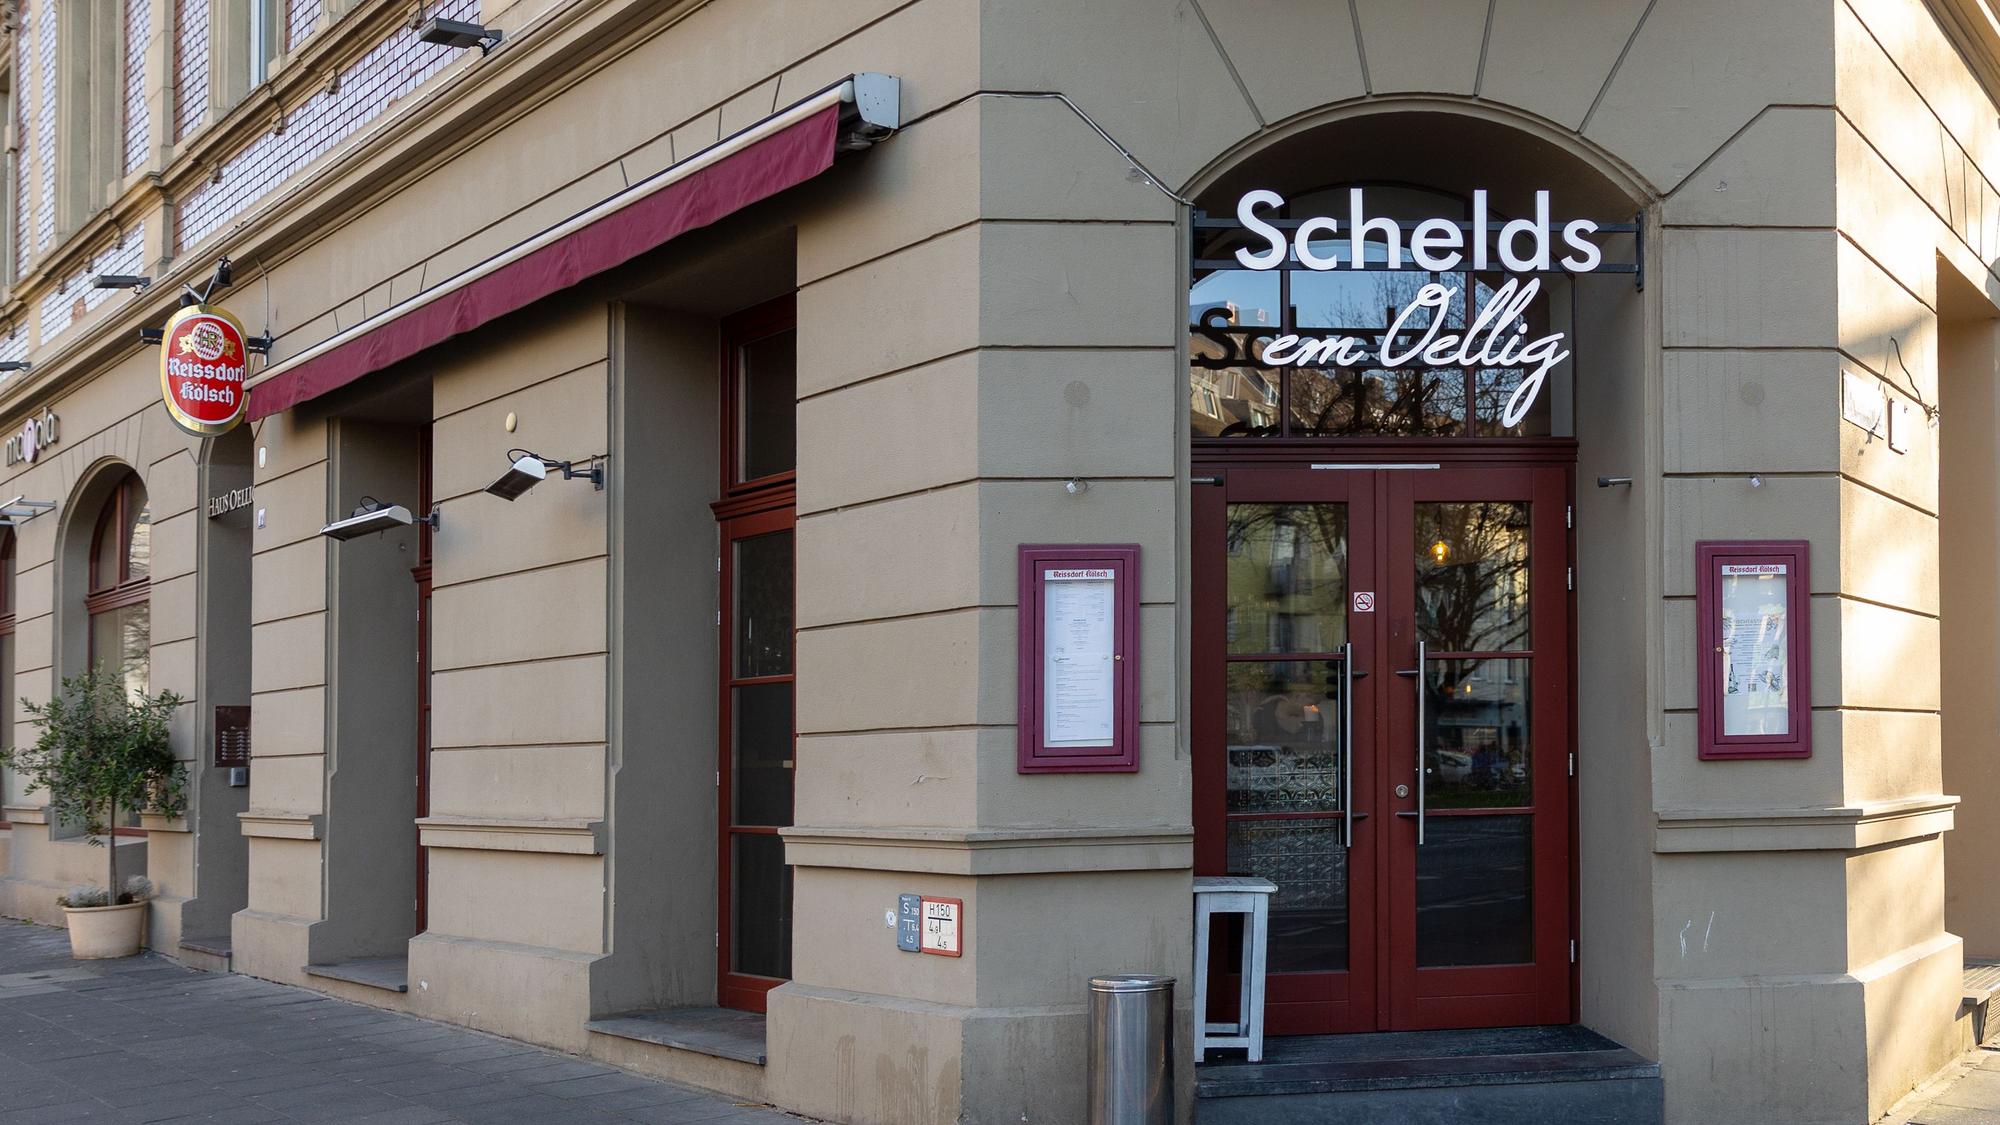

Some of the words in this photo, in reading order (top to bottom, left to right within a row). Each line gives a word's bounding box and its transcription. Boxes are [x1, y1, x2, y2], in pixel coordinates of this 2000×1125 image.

[1234, 187, 1602, 273] Schelds
[1262, 330, 1366, 367] em
[1380, 277, 1571, 430] Oellig
[168, 357, 245, 382] Reissdorf
[180, 381, 234, 406] Kölsch
[208, 494, 229, 518] HAUS
